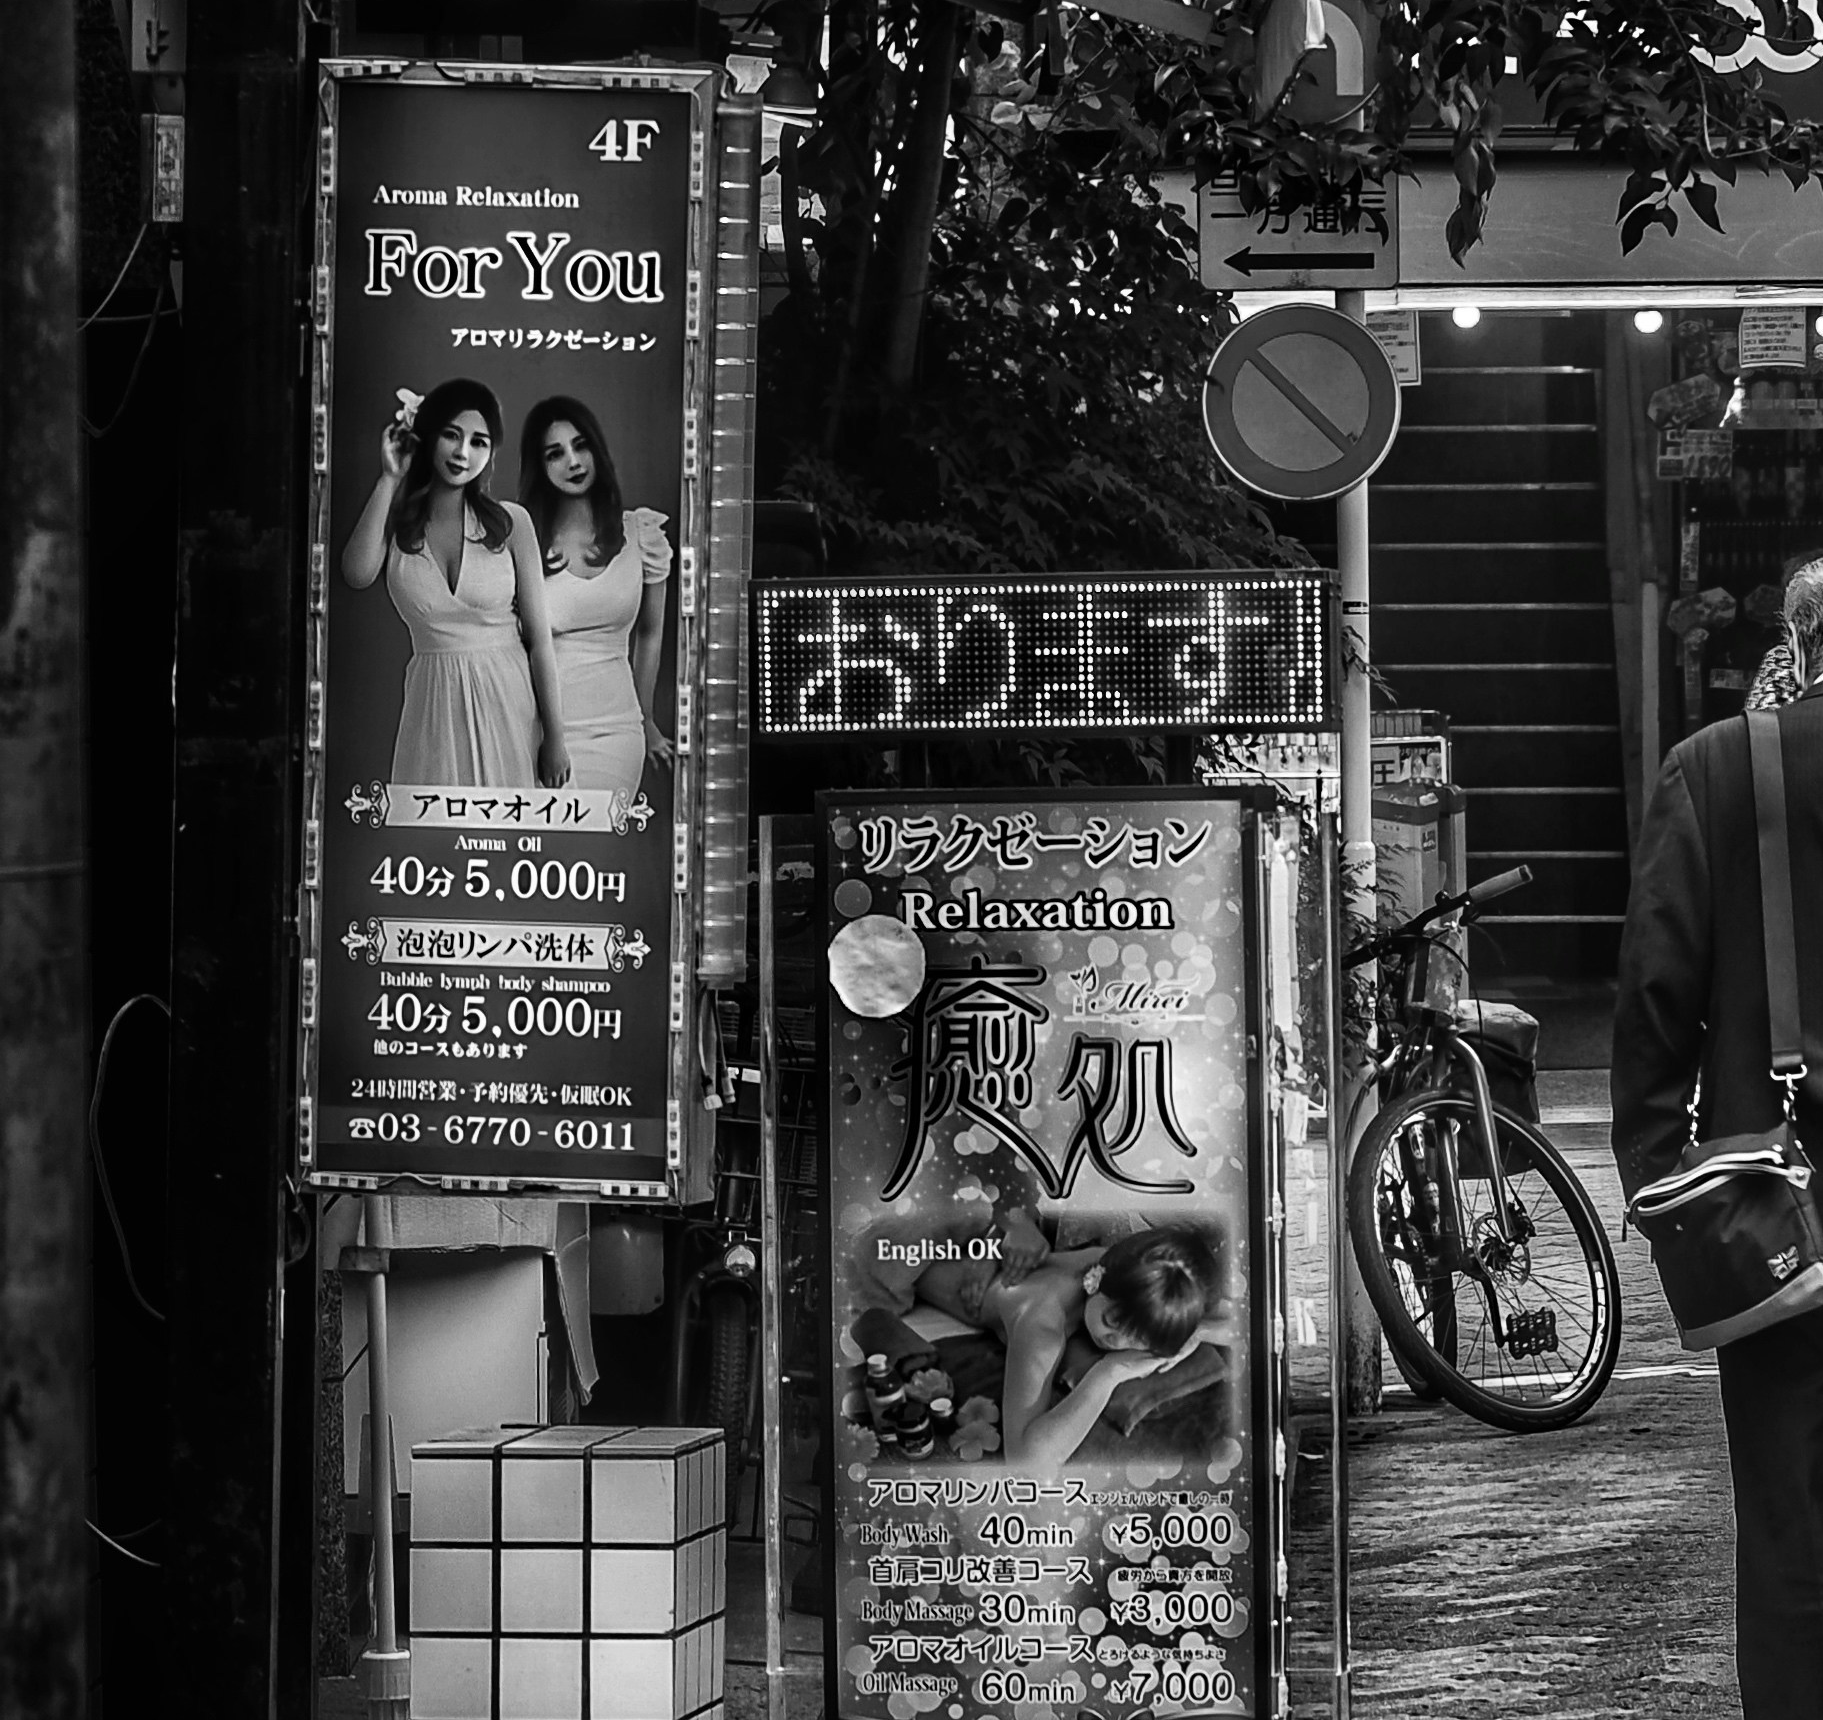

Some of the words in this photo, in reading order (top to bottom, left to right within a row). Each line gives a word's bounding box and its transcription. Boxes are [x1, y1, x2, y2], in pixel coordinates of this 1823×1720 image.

[588, 119, 661, 162] 4F
[372, 185, 448, 207] Aroma
[455, 186, 580, 209] Relaxation
[364, 228, 501, 298] For
[506, 230, 665, 303] You
[450, 327, 657, 351] アロマリラクゼーション
[412, 792, 592, 825] アロマオイル
[454, 835, 507, 852] Aroma
[517, 836, 542, 852] Oil
[859, 814, 1212, 872] リラクゼーション
[900, 889, 1176, 931] Relaxation
[396, 929, 596, 963] 泡泡リンパ洗体
[380, 971, 433, 988] Bubble
[440, 973, 490, 991] lymph
[498, 975, 536, 993] body
[541, 976, 612, 994] shampoo
[373, 1039, 528, 1059] 他のコースもあります
[879, 953, 1198, 1201] 癒処
[876, 1239, 961, 1266] English
[967, 1238, 1002, 1261] OK
[868, 1479, 1089, 1506] アロマリンパコース
[861, 1524, 900, 1549] Body
[904, 1524, 949, 1545] Wash
[980, 1514, 1075, 1547] 40min
[869, 1556, 1093, 1584] 首肩コリ改善コース
[861, 1600, 901, 1626] Body
[905, 1600, 974, 1625] Massage
[980, 1593, 1076, 1626] 30min
[870, 1636, 1095, 1663] アロマオイルコース
[862, 1672, 887, 1694] Oil
[888, 1672, 958, 1697] Massage
[980, 1670, 1076, 1703] 60min
